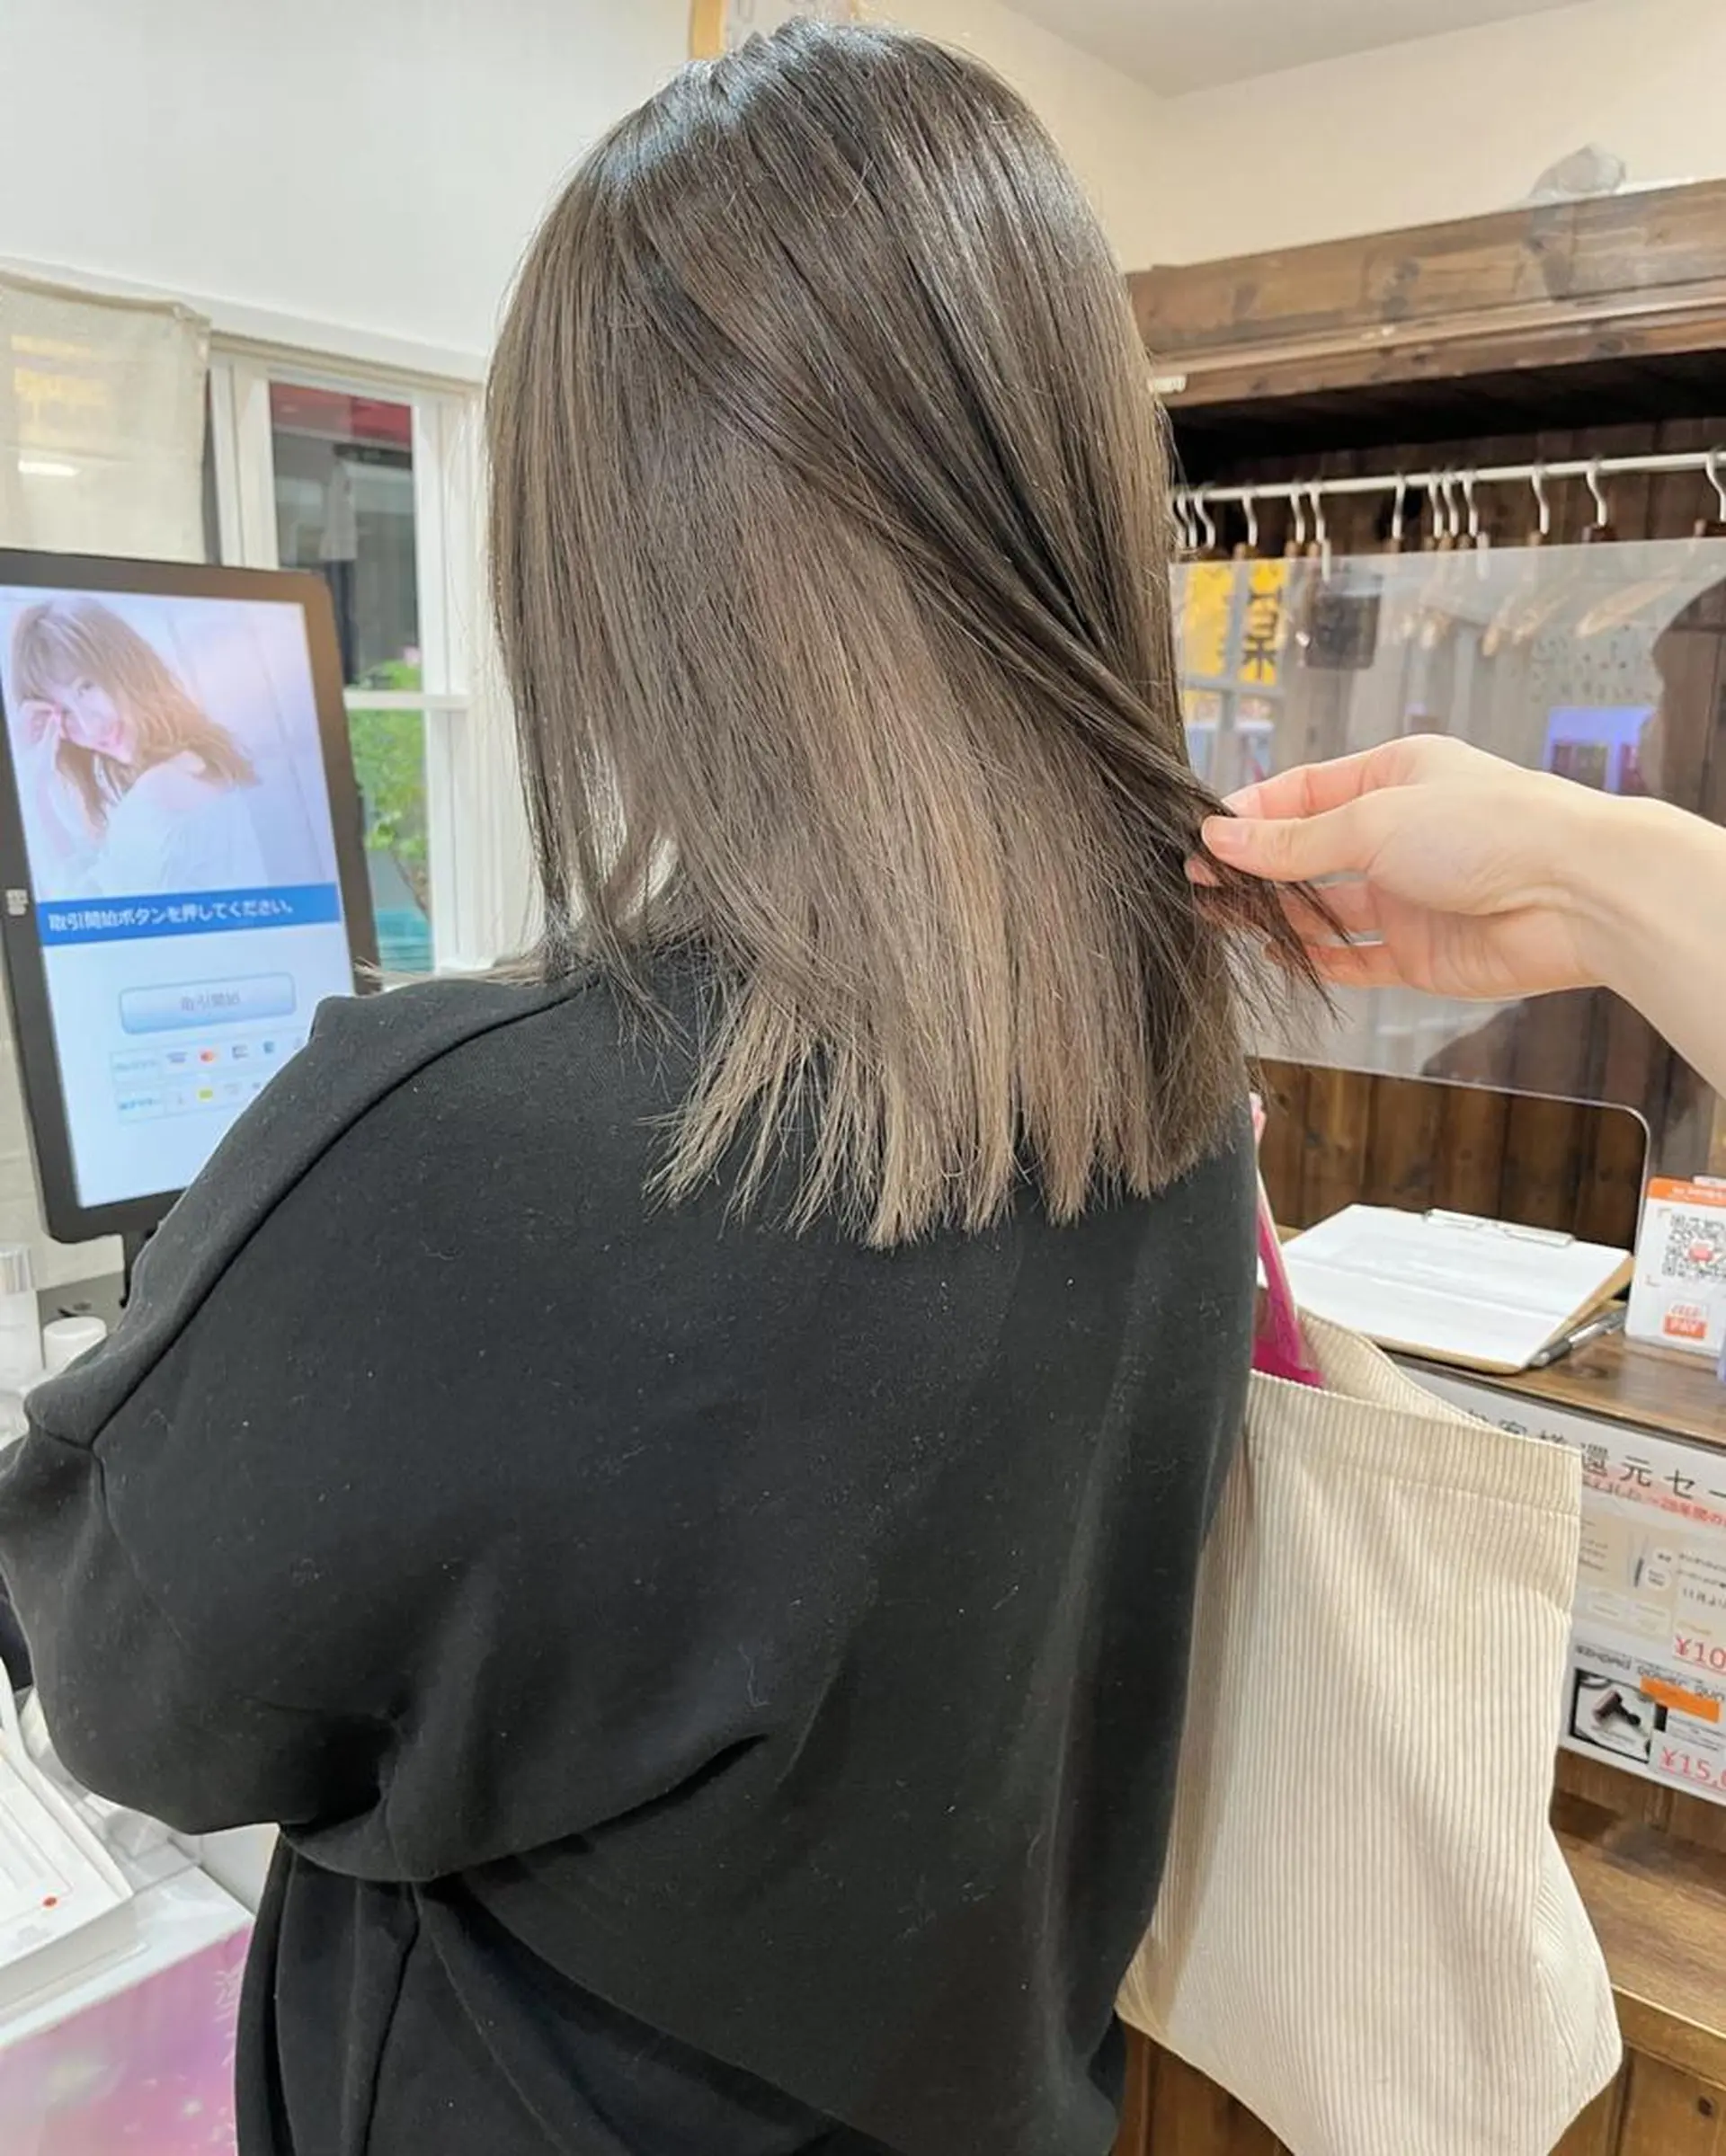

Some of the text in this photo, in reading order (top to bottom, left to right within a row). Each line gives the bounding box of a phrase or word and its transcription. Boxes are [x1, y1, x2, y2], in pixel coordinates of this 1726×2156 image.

[48, 899, 293, 931] 取引開始ボタンを押してください。
